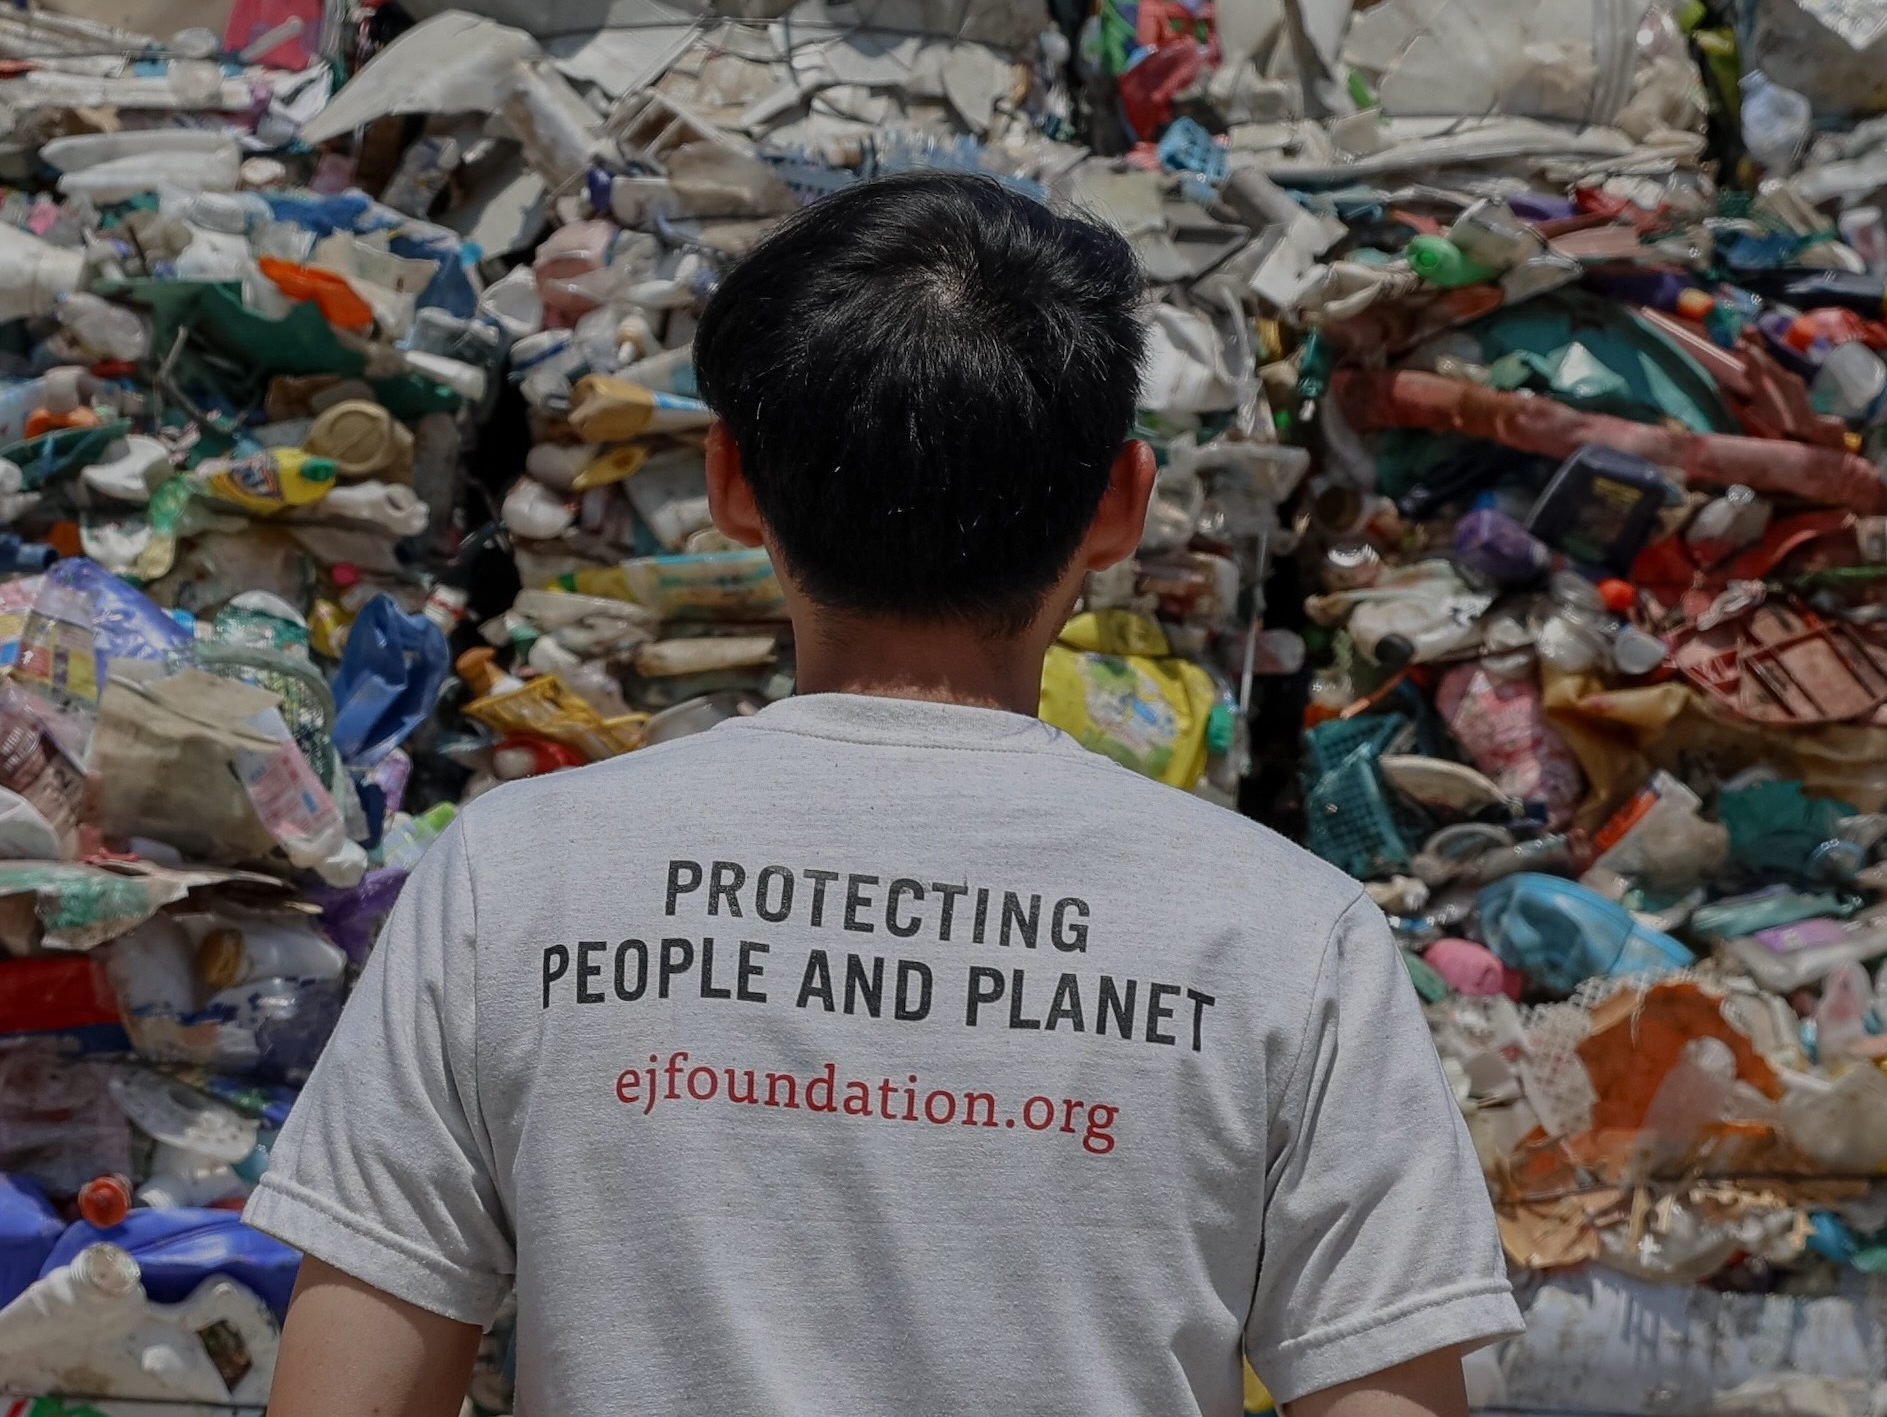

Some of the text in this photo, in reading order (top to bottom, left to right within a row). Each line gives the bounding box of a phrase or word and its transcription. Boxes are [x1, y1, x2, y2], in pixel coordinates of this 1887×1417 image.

[665, 860, 1090, 953] PROTECTING
[542, 937, 1216, 1053] PEOPLE AND PLANET
[615, 1051, 1120, 1155] ejfoundation.org
